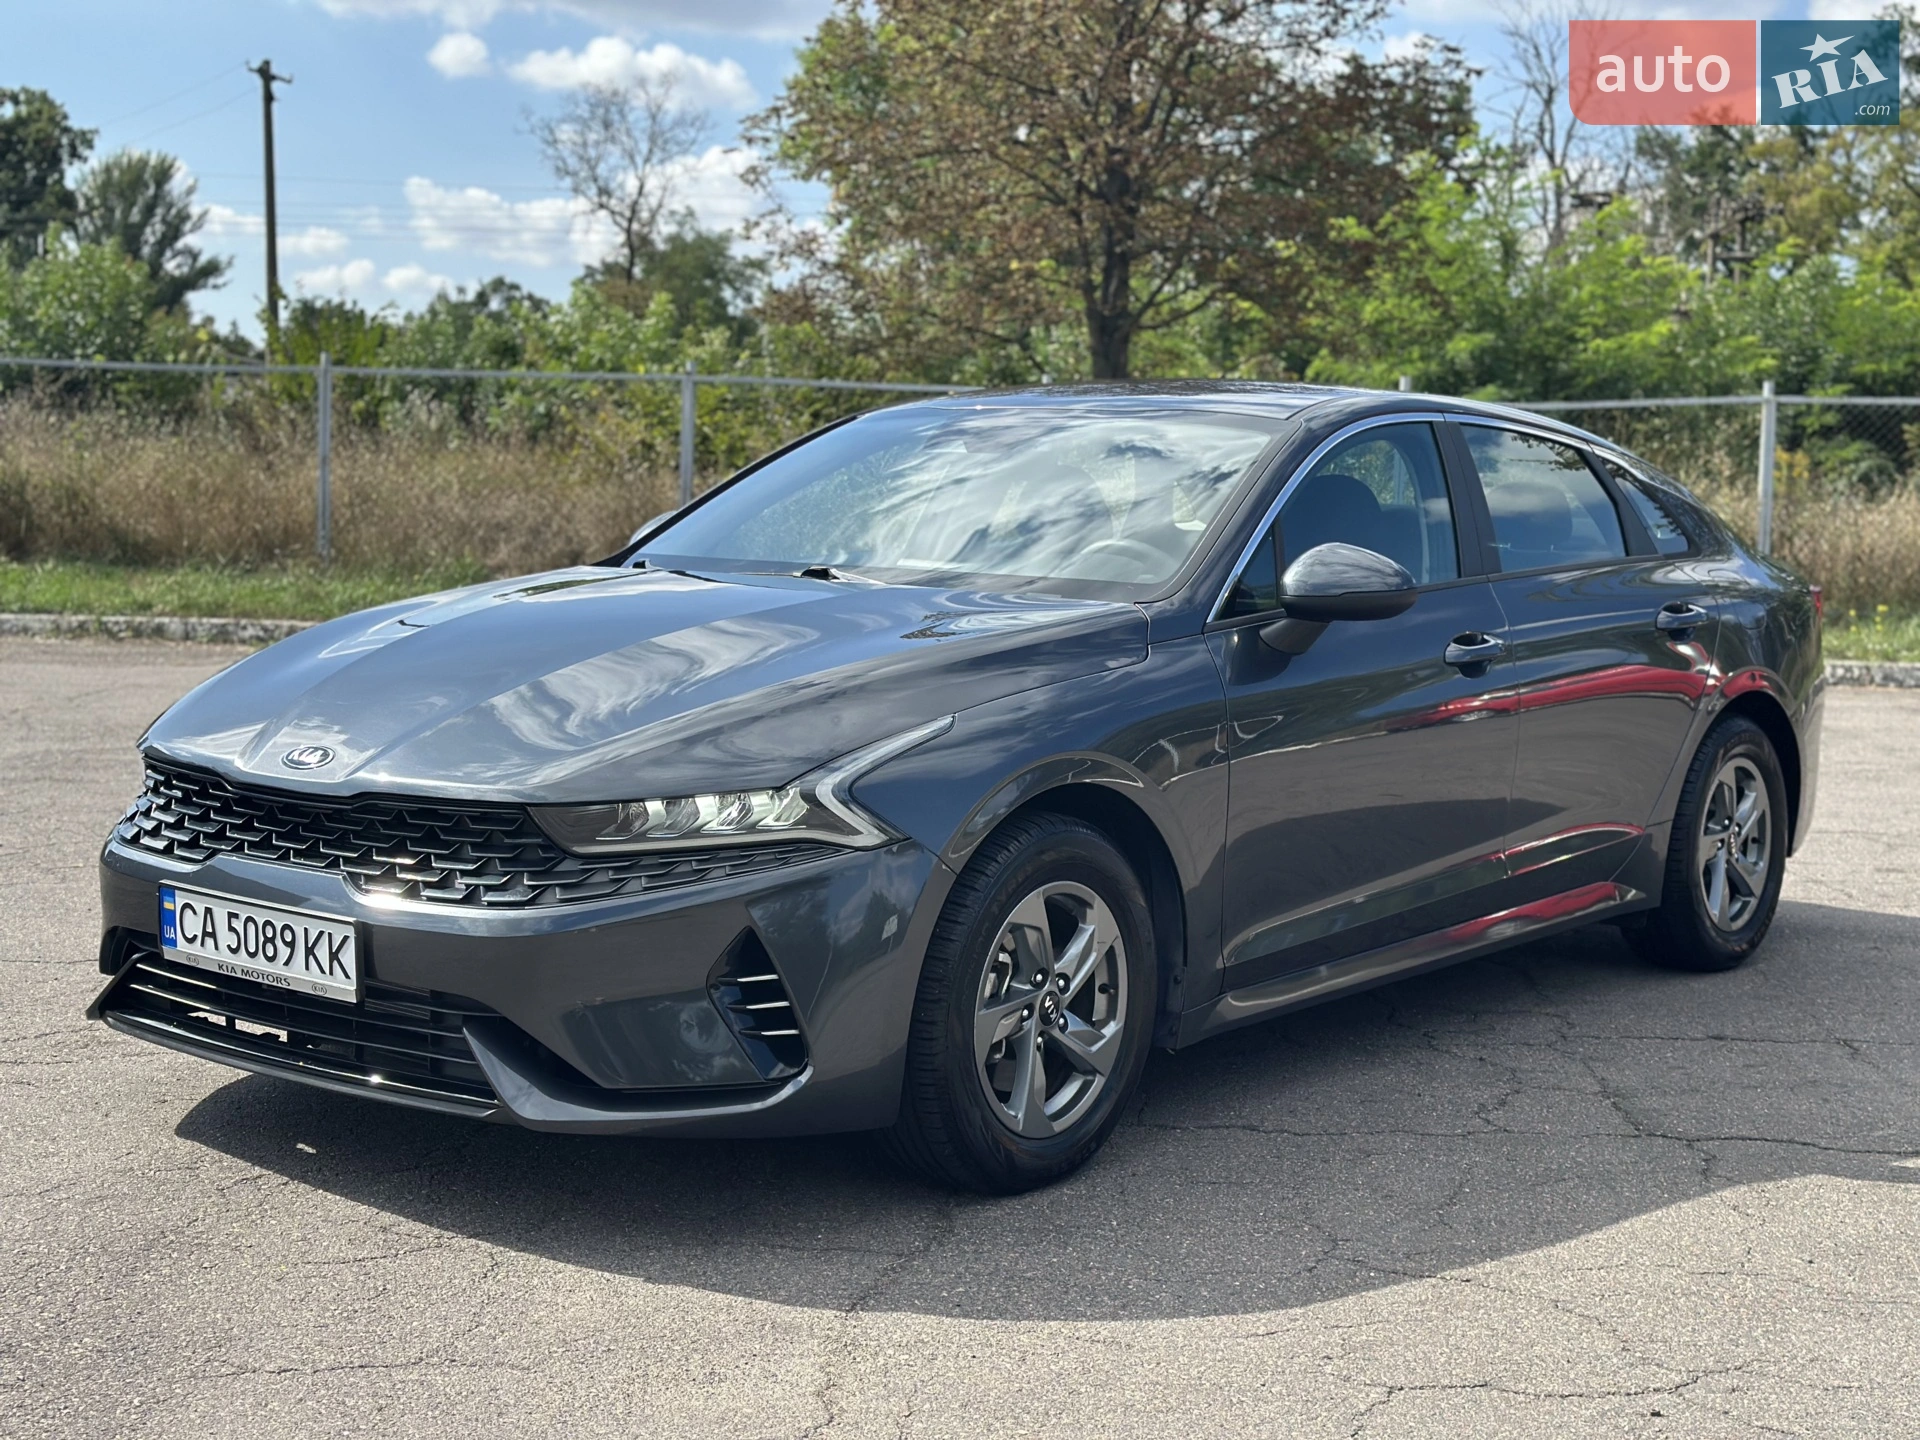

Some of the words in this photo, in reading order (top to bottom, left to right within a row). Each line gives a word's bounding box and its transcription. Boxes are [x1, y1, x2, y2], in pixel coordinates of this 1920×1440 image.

[288, 748, 325, 764] KIA
[164, 924, 176, 940] UA
[179, 902, 219, 951] CA
[226, 911, 297, 967] 5089
[304, 926, 351, 979] KK
[218, 963, 237, 976] KIA
[241, 968, 291, 987] MOTORS
